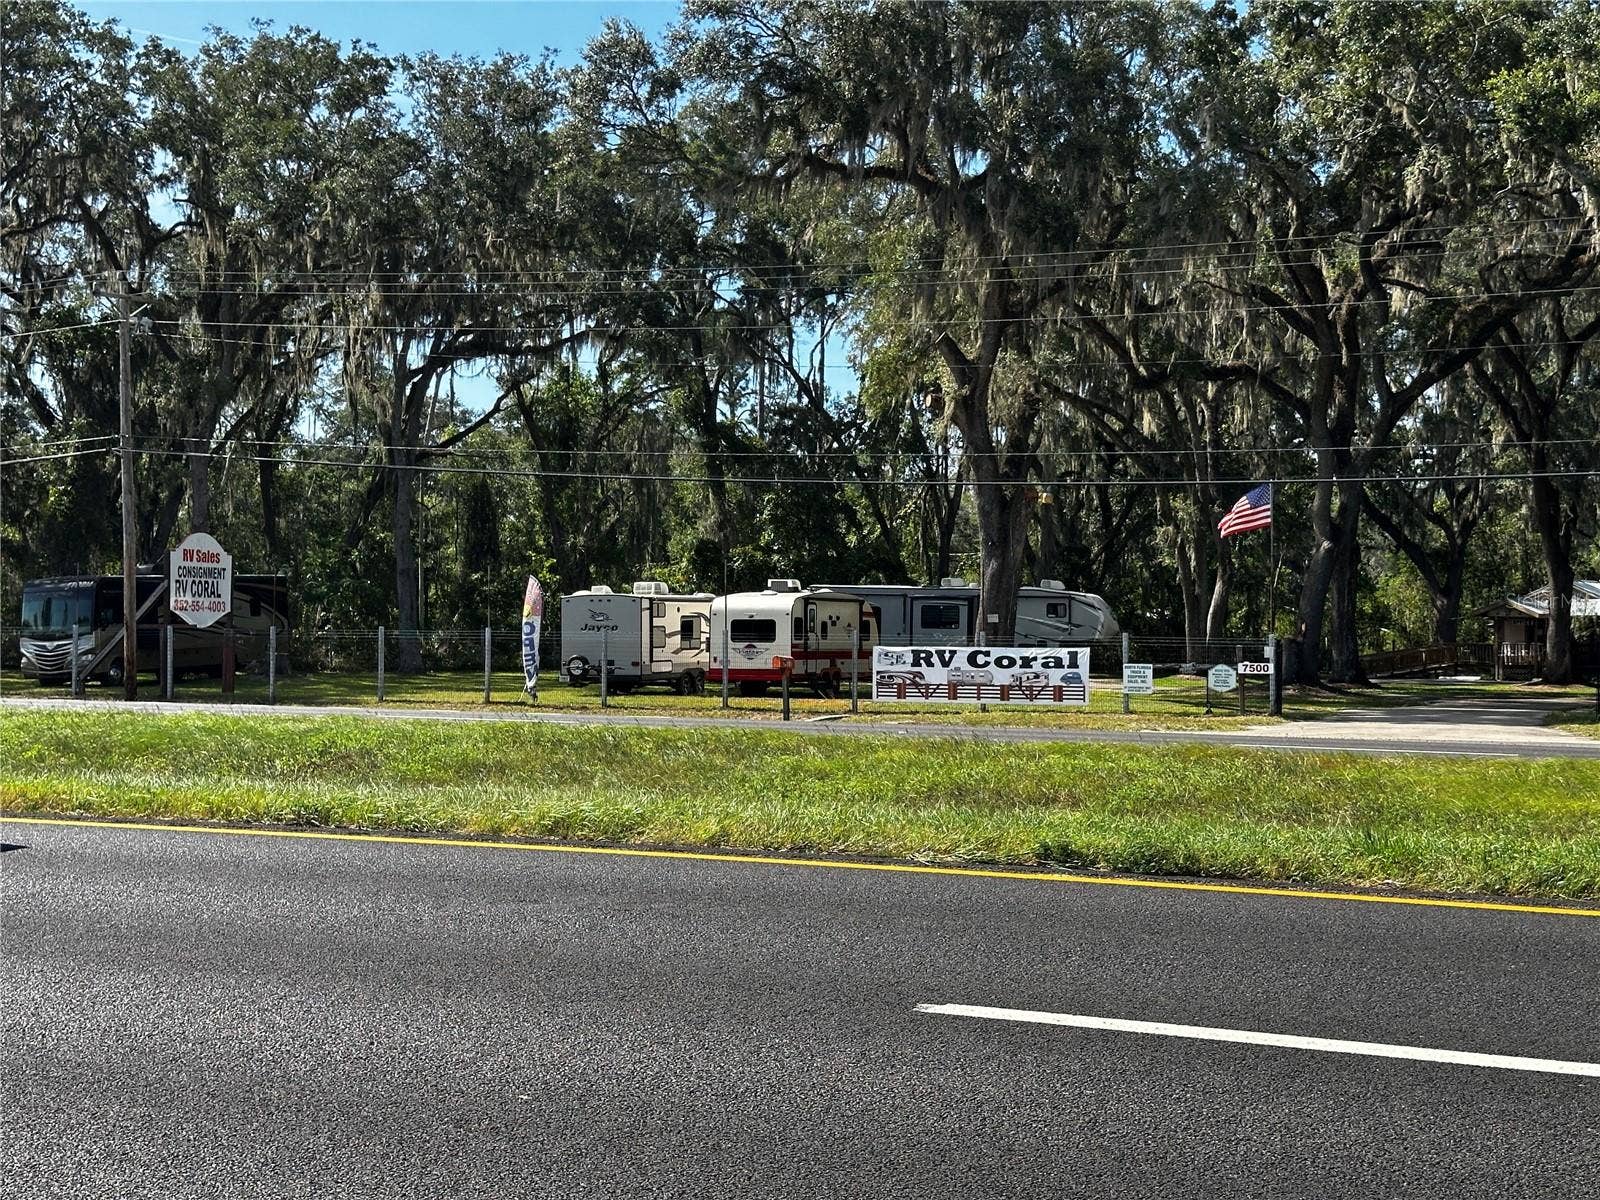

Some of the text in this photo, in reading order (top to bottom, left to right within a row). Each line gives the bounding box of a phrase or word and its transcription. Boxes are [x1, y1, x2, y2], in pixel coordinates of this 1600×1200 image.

[182, 548, 221, 564] RV Sales
[177, 565, 227, 580] CONSIGNMENT
[174, 579, 222, 599] RV CORAL
[173, 599, 226, 612] 352-554-4003
[580, 623, 619, 632] Jayco
[910, 649, 1080, 669] RV Coral
[1242, 664, 1270, 673] 7500
